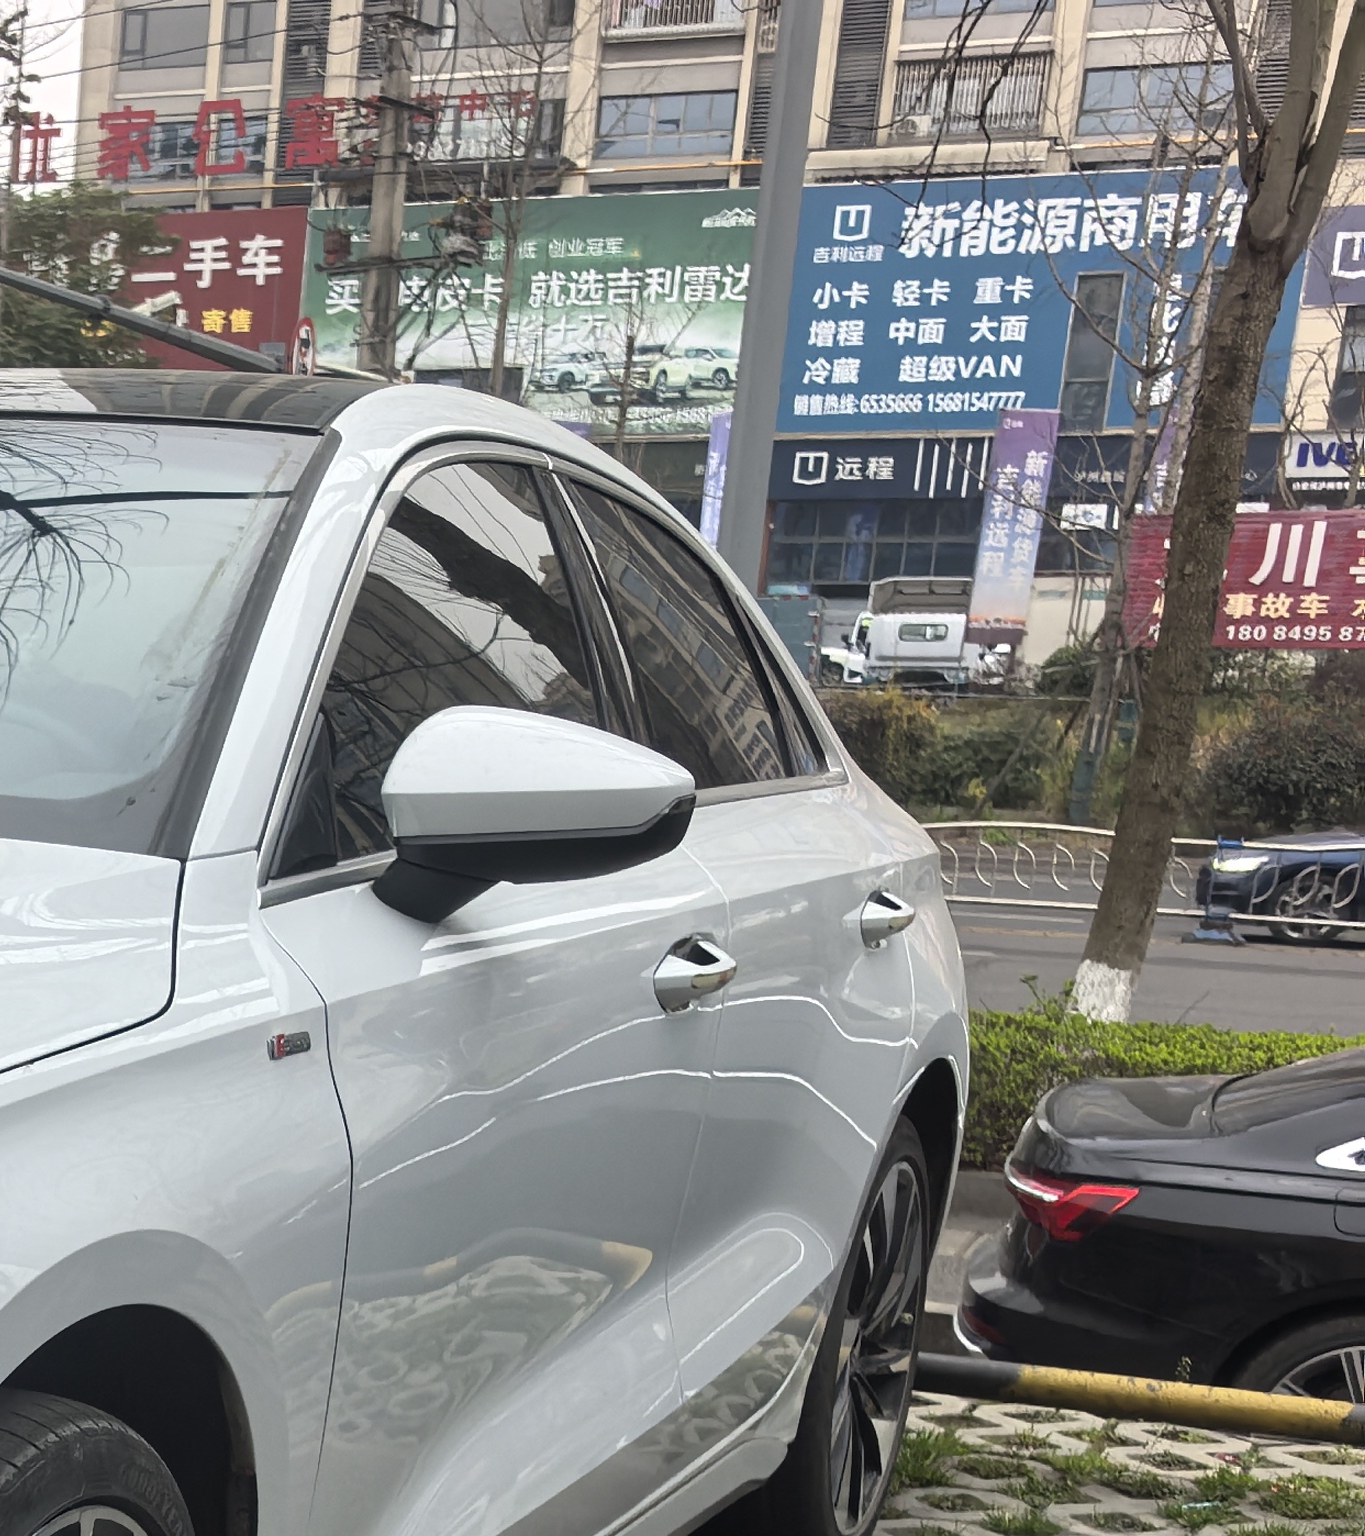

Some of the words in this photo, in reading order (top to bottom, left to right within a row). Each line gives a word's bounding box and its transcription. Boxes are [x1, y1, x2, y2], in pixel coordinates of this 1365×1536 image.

[812, 244, 885, 264] 吉利远程
[528, 262, 752, 309] 就选吉利雷达
[812, 280, 871, 310] 小卡
[891, 277, 952, 308] 轻卡
[972, 275, 1034, 305] 重卡
[200, 308, 254, 334] 寄售
[807, 319, 866, 348] 增程
[888, 317, 948, 346] 中面
[969, 314, 1030, 344] 大面
[802, 357, 862, 386] 冷藏
[897, 354, 1023, 383] 超级VAN
[833, 456, 896, 482] 远程
[1222, 592, 1331, 620] 事故车
[1225, 625, 1267, 642] 180
[1272, 624, 1333, 642] 8495
